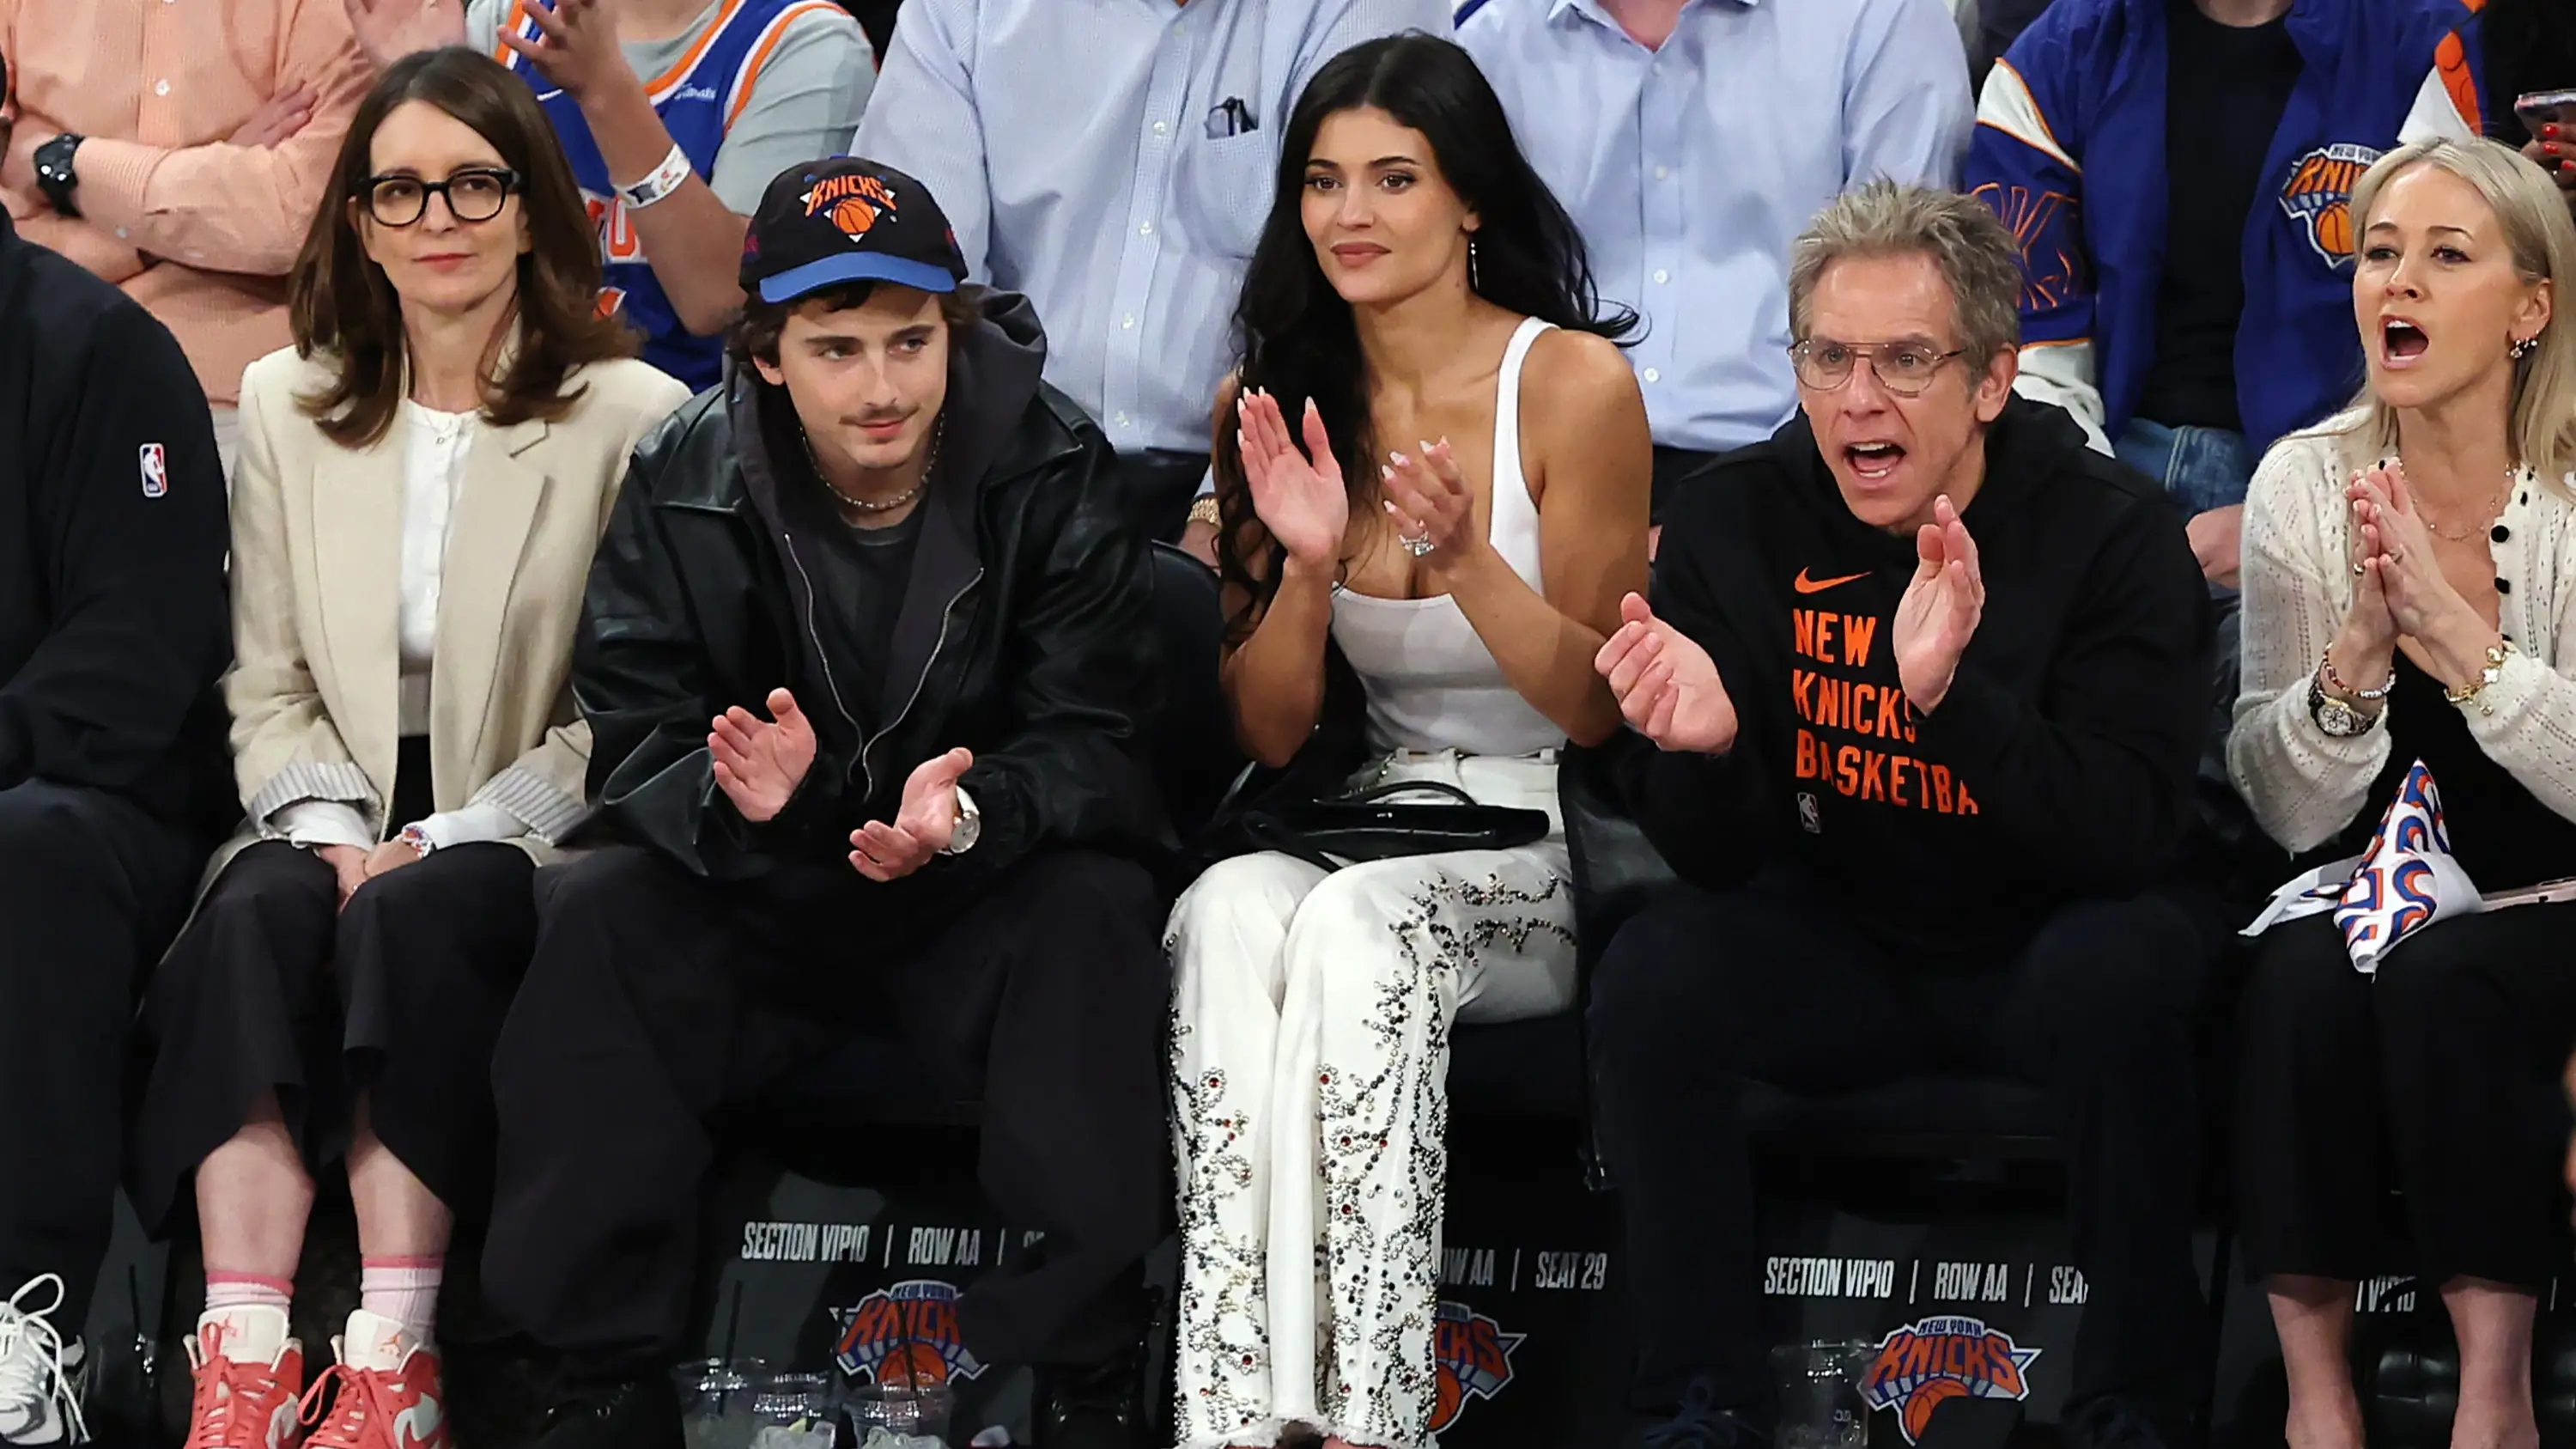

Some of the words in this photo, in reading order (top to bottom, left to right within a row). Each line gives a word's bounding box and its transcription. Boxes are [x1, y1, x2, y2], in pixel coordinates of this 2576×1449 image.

[805, 174, 896, 216] KNICKS
[2287, 156, 2370, 197] KNI
[1793, 608, 1876, 667] NEW
[1796, 728, 1978, 815] BASKETBA
[741, 1221, 818, 1261] SECTION
[908, 1227, 955, 1264] ROW
[955, 1228, 981, 1265] AA
[1438, 1247, 1468, 1285] OW
[1469, 1249, 1495, 1286] AA
[1535, 1251, 1578, 1288] SEAT
[1581, 1253, 1607, 1290] 29
[1765, 1257, 1843, 1297] SECTION
[1934, 1262, 1982, 1300] ROW
[1981, 1263, 2008, 1302] AA
[838, 1299, 961, 1355] KNICK
[1919, 1319, 1947, 1333] NEW
[1435, 1319, 1506, 1379] CKS
[1865, 1333, 2021, 1395] KNICKS
